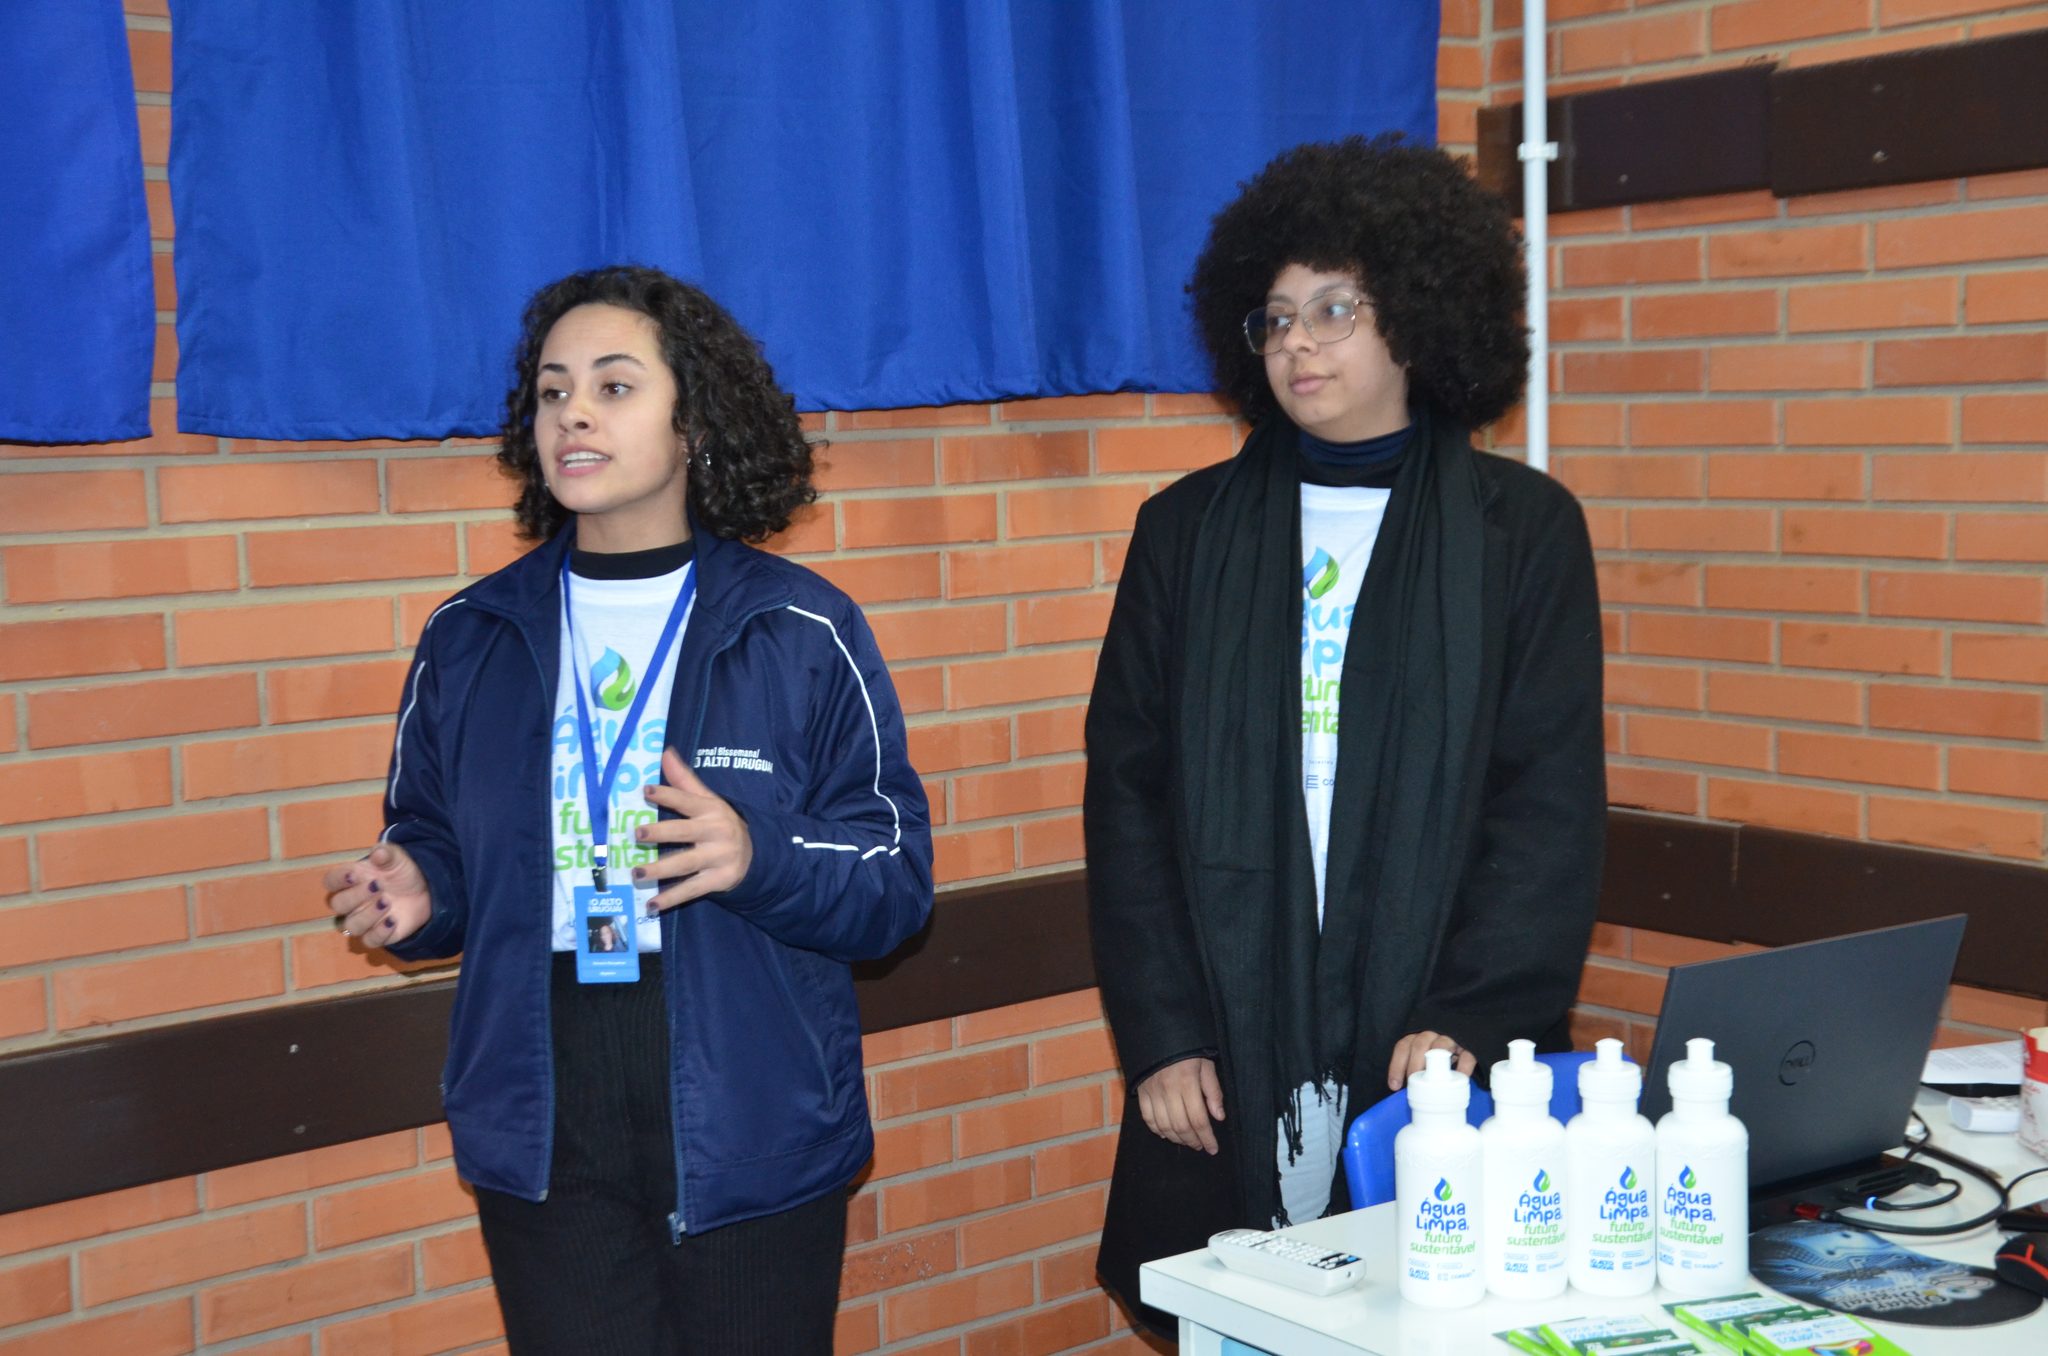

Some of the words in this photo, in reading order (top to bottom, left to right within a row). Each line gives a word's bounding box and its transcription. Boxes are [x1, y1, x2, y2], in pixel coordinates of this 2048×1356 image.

[702, 756, 730, 768] ALTO
[560, 802, 657, 835] fuuro
[1519, 1190, 1561, 1211] Água
[1605, 1187, 1647, 1208] Água
[1667, 1184, 1711, 1206] Água
[1420, 1197, 1466, 1219] Água
[1524, 1224, 1559, 1234] futuro
[1610, 1221, 1645, 1232] futuro
[1670, 1217, 1707, 1232] futuro
[1425, 1231, 1463, 1244] futuro
